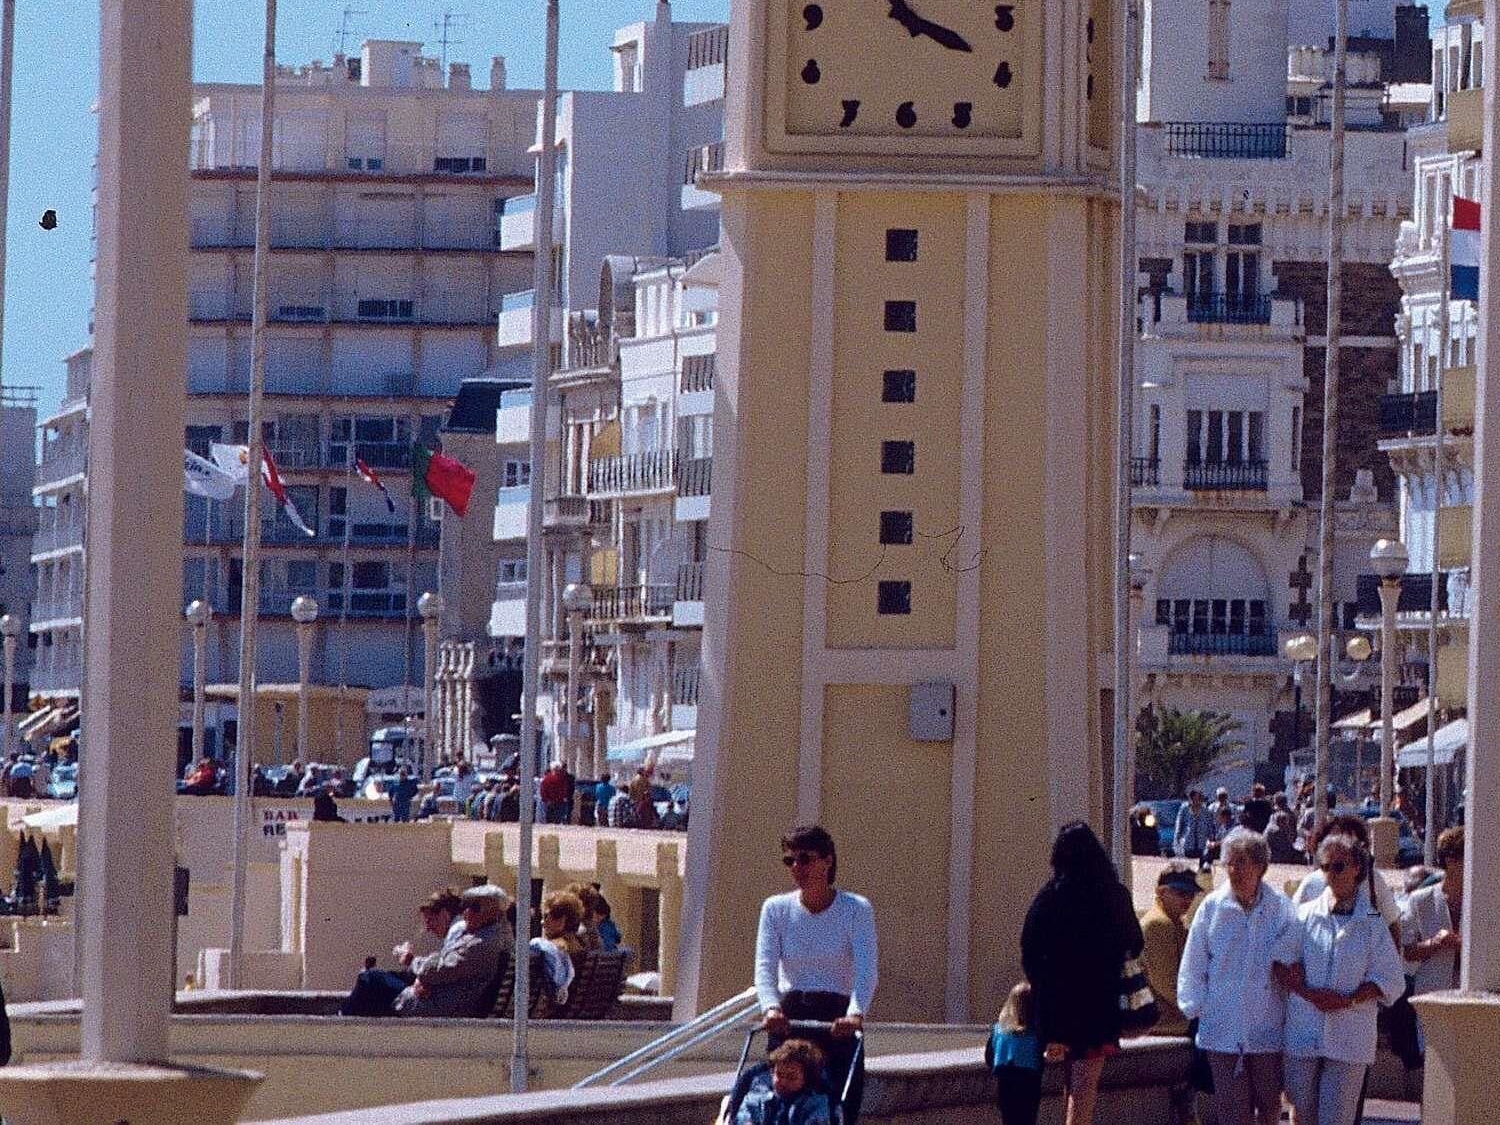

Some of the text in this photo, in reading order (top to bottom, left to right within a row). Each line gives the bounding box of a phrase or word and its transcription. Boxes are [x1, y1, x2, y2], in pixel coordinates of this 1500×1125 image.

[803, 4, 824, 31] 9
[995, 5, 1015, 32] 3
[800, 58, 821, 84] 8
[993, 60, 1013, 89] 4
[839, 100, 860, 128] 7
[895, 101, 917, 128] 6
[951, 101, 972, 129] 5
